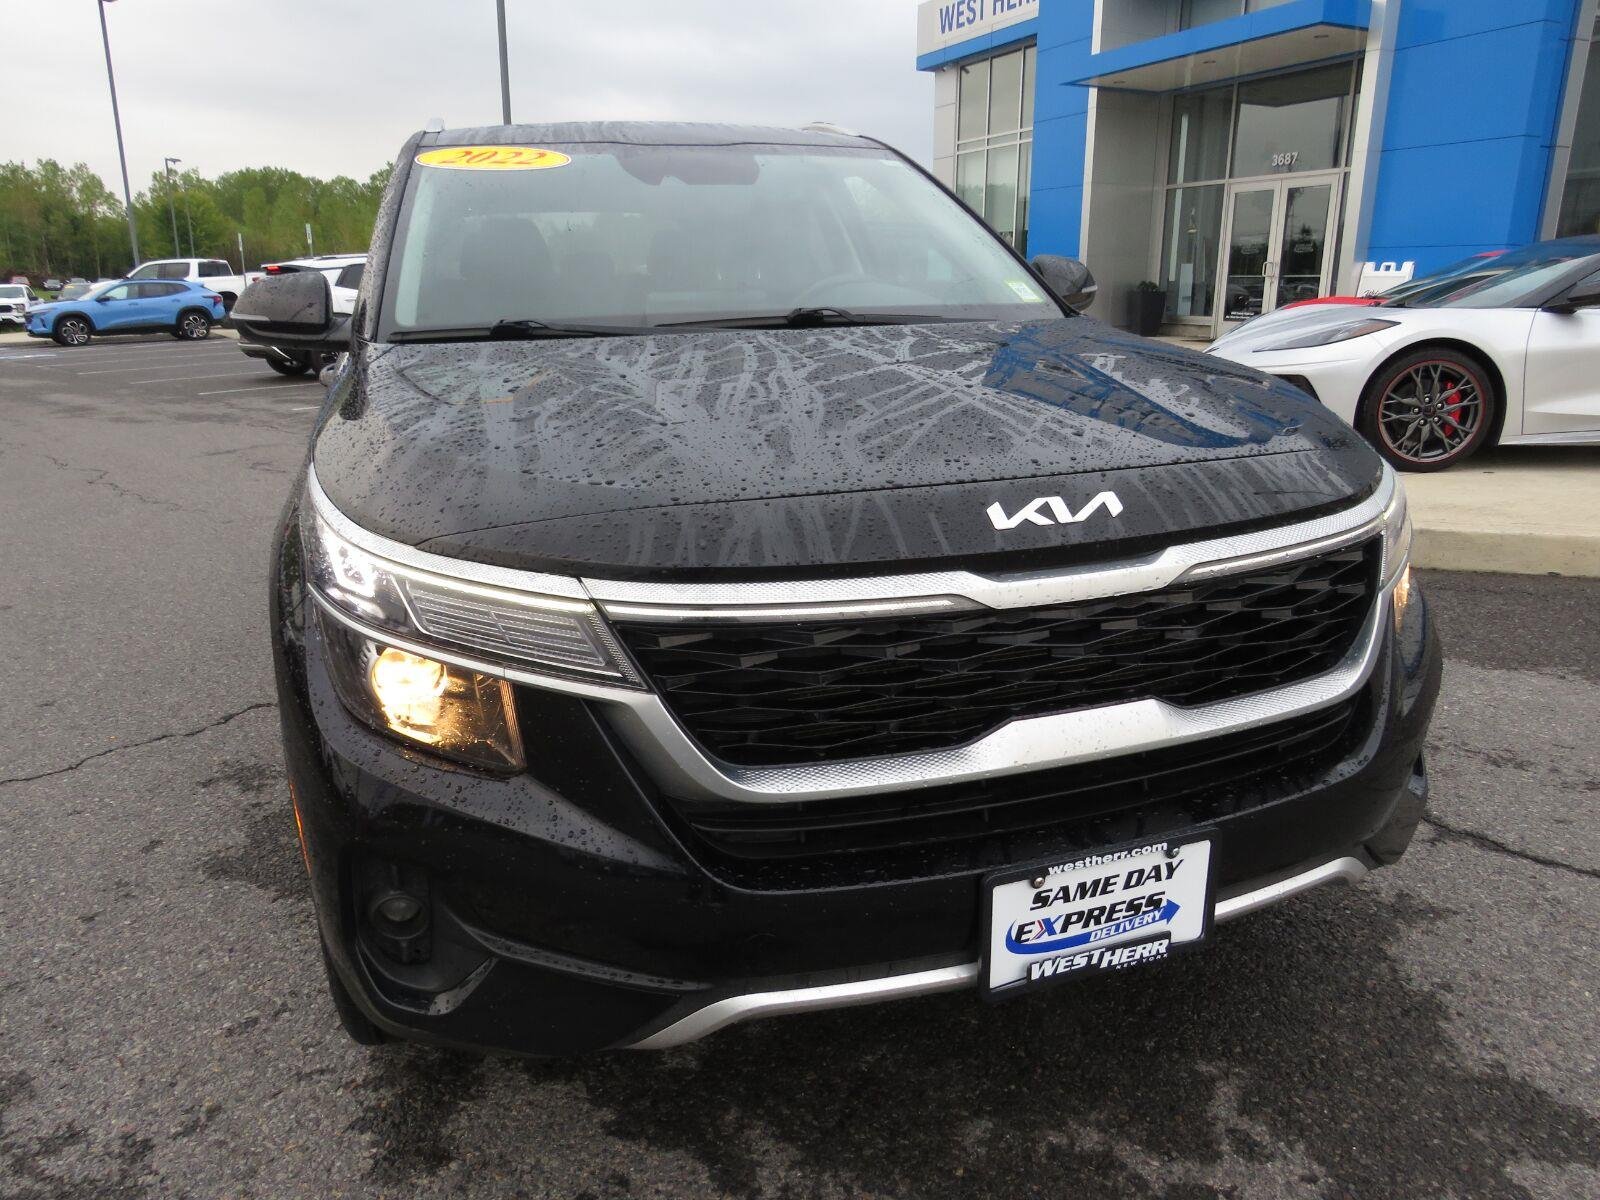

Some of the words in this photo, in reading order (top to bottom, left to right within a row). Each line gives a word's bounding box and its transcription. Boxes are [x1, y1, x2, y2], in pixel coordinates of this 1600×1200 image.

[940, 0, 984, 34] WEST
[438, 150, 547, 164] 2022
[1271, 152, 1298, 166] 3687
[1048, 842, 1168, 876] westherr.com
[1029, 874, 1119, 911] SAME
[1122, 859, 1184, 890] DAY
[1014, 891, 1166, 944] EXPRESS
[1089, 908, 1164, 943] DELIVERY
[1115, 961, 1138, 970] NEW
[1142, 953, 1169, 963] YORK
